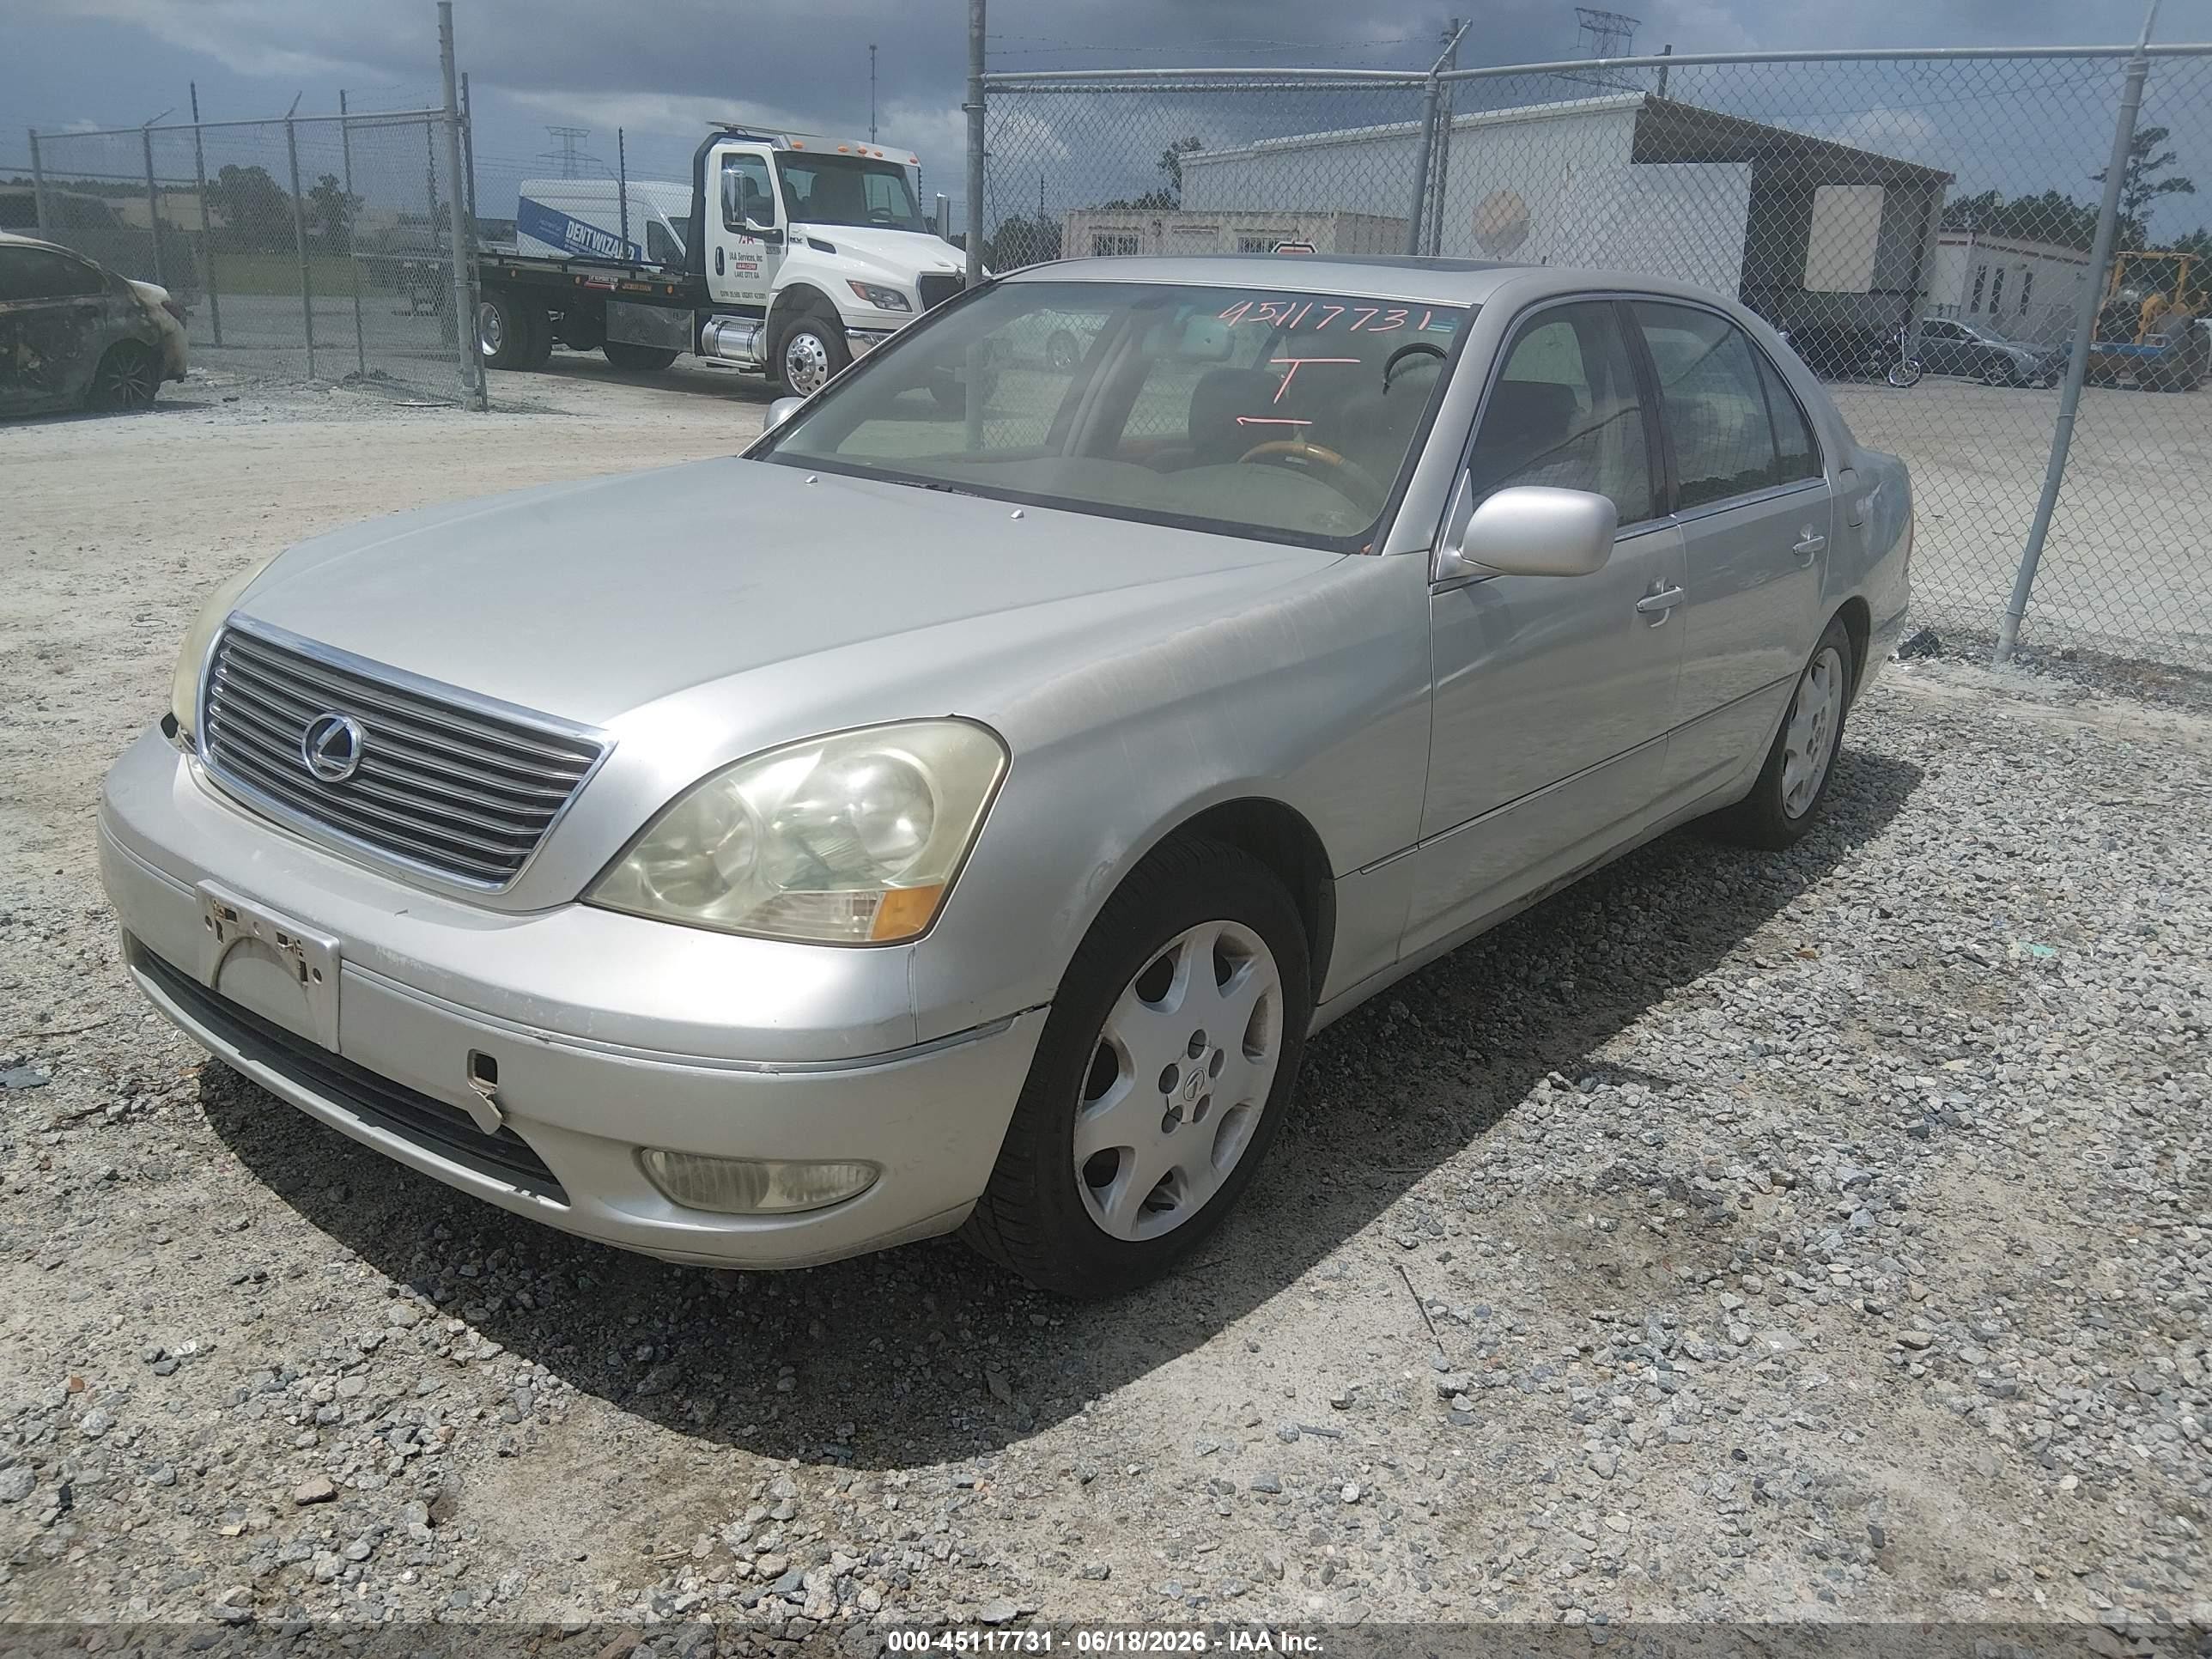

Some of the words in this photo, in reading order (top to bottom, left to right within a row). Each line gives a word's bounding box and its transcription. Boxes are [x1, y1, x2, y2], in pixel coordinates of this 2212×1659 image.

[566, 220, 635, 260] DENTWIZAD
[1218, 300, 1432, 331] 45117731
[1270, 357, 1361, 404] T
